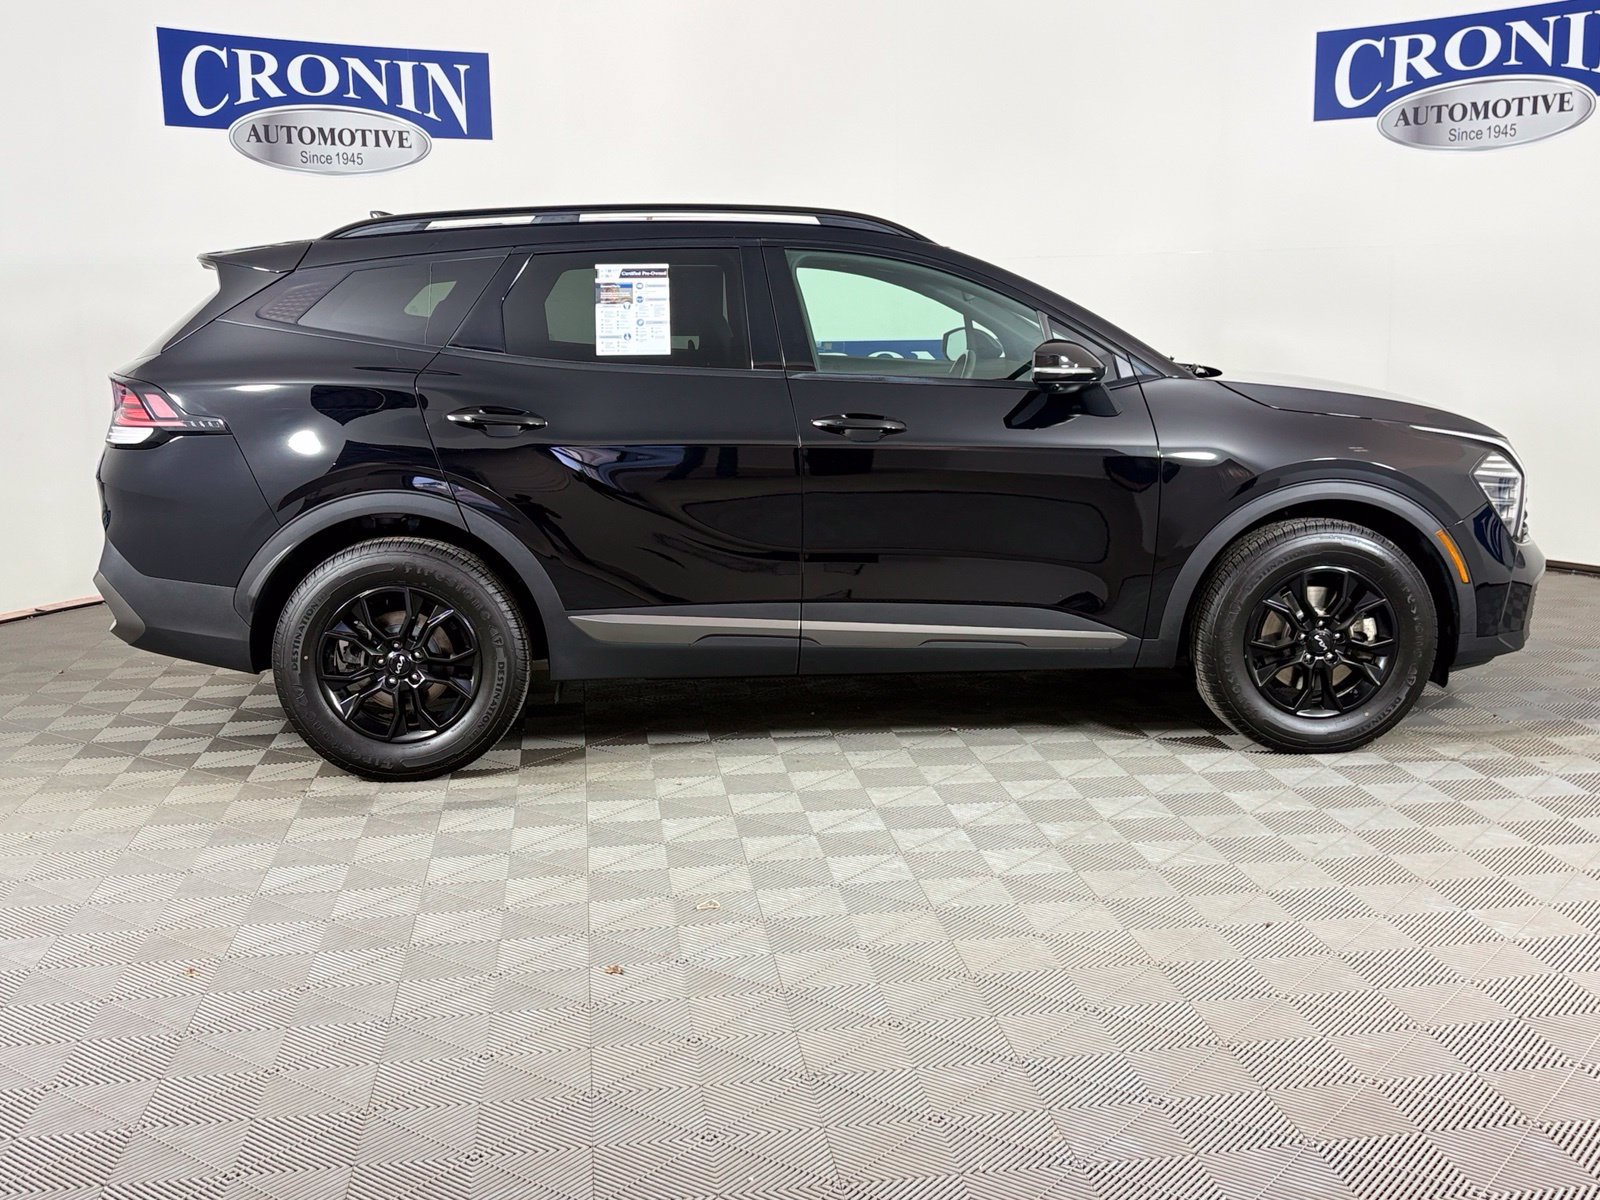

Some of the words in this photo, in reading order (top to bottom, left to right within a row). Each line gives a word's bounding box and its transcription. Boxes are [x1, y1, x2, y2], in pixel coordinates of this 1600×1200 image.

[1335, 9, 1600, 109] CRONI
[181, 44, 470, 135] CRONIN
[1394, 91, 1574, 128] AUTOMOTIVE
[246, 123, 413, 150] AUTOMOTIVE
[300, 150, 333, 165] Since
[335, 151, 364, 167] 1945
[1448, 127, 1483, 143] Since
[1486, 123, 1517, 141] 1945
[291, 602, 318, 671] DESTINATION
[478, 661, 505, 731] DESTINATION
